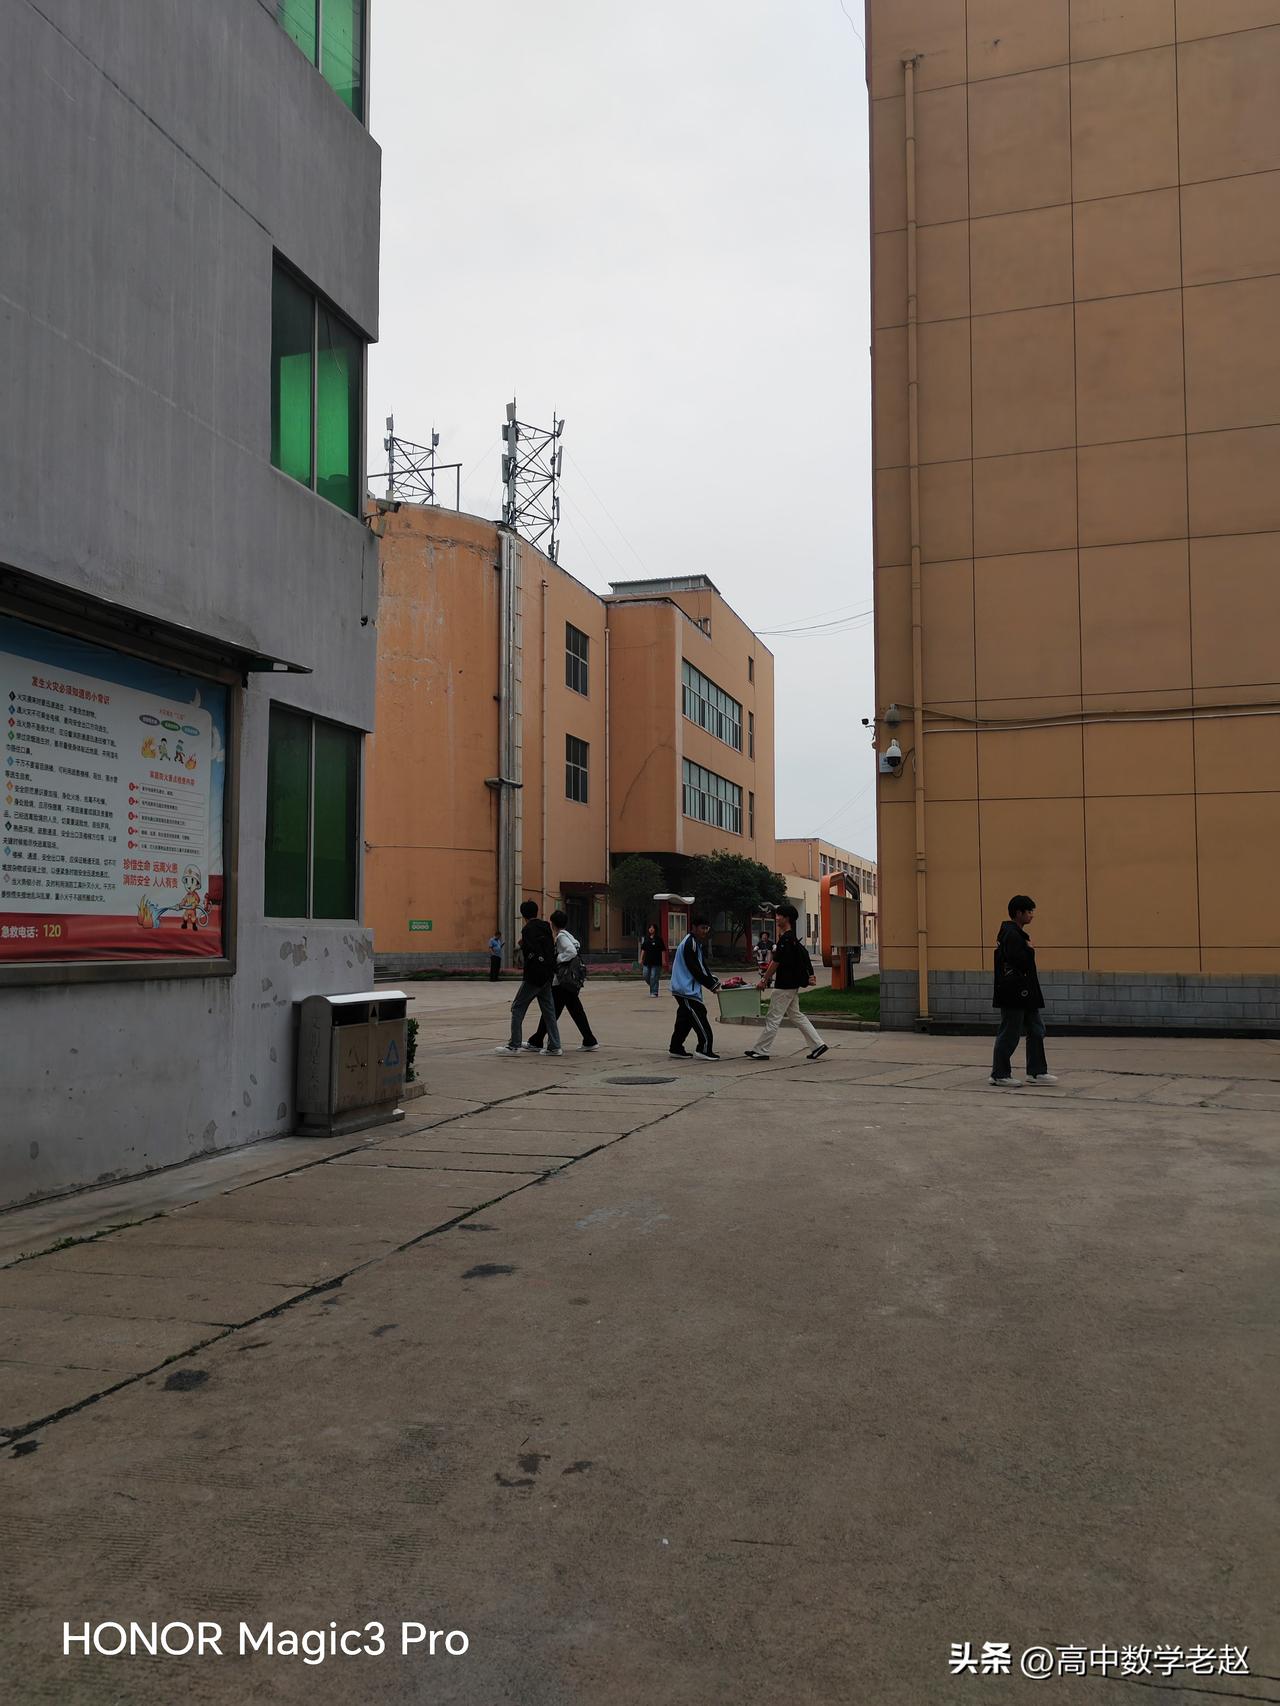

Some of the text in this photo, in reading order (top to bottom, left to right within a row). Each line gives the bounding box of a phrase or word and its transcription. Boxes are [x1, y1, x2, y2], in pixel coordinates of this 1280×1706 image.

[123, 859, 151, 871] 珍惜生命
[123, 874, 178, 888] 消防安全 人人有责
[43, 924, 62, 937] 120
